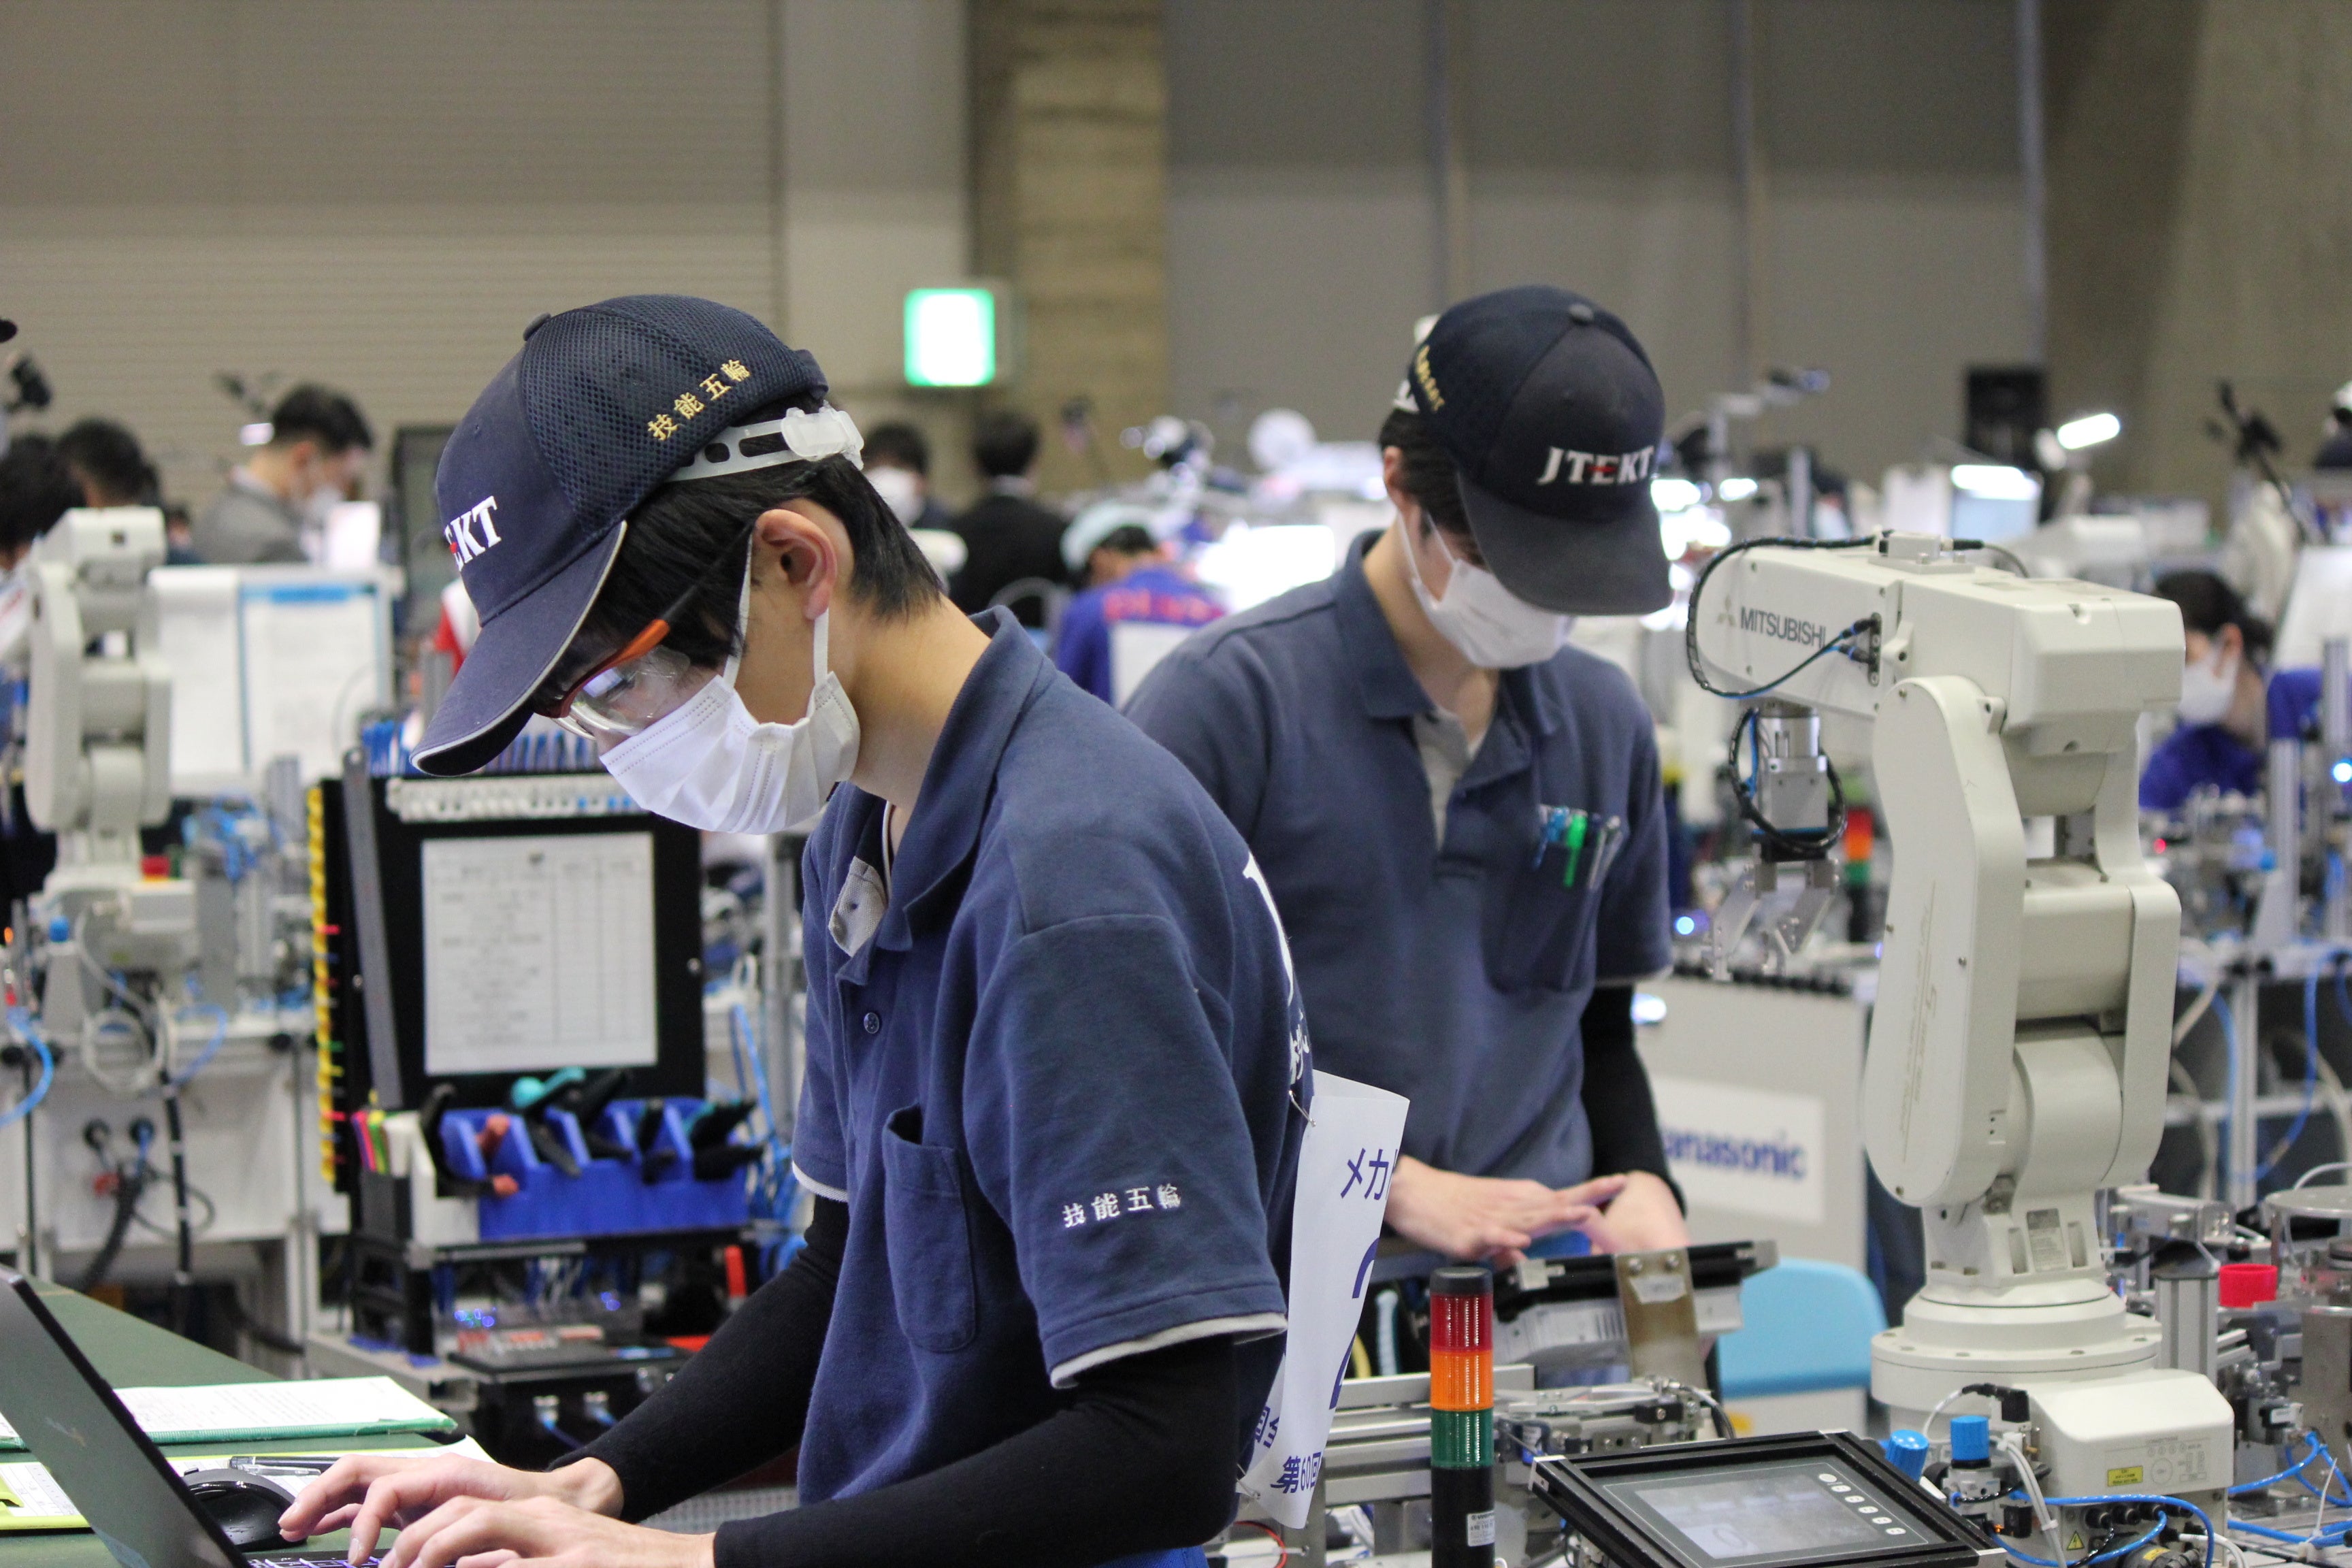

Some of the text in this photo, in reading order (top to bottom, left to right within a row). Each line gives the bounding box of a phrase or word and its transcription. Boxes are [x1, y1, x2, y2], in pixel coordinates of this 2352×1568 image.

[647, 359, 751, 440] 技能五輪
[1536, 446, 1654, 485] JTEKT
[1740, 606, 1827, 649] MITSUBISHI
[1062, 1183, 1181, 1228] 技能五輪
